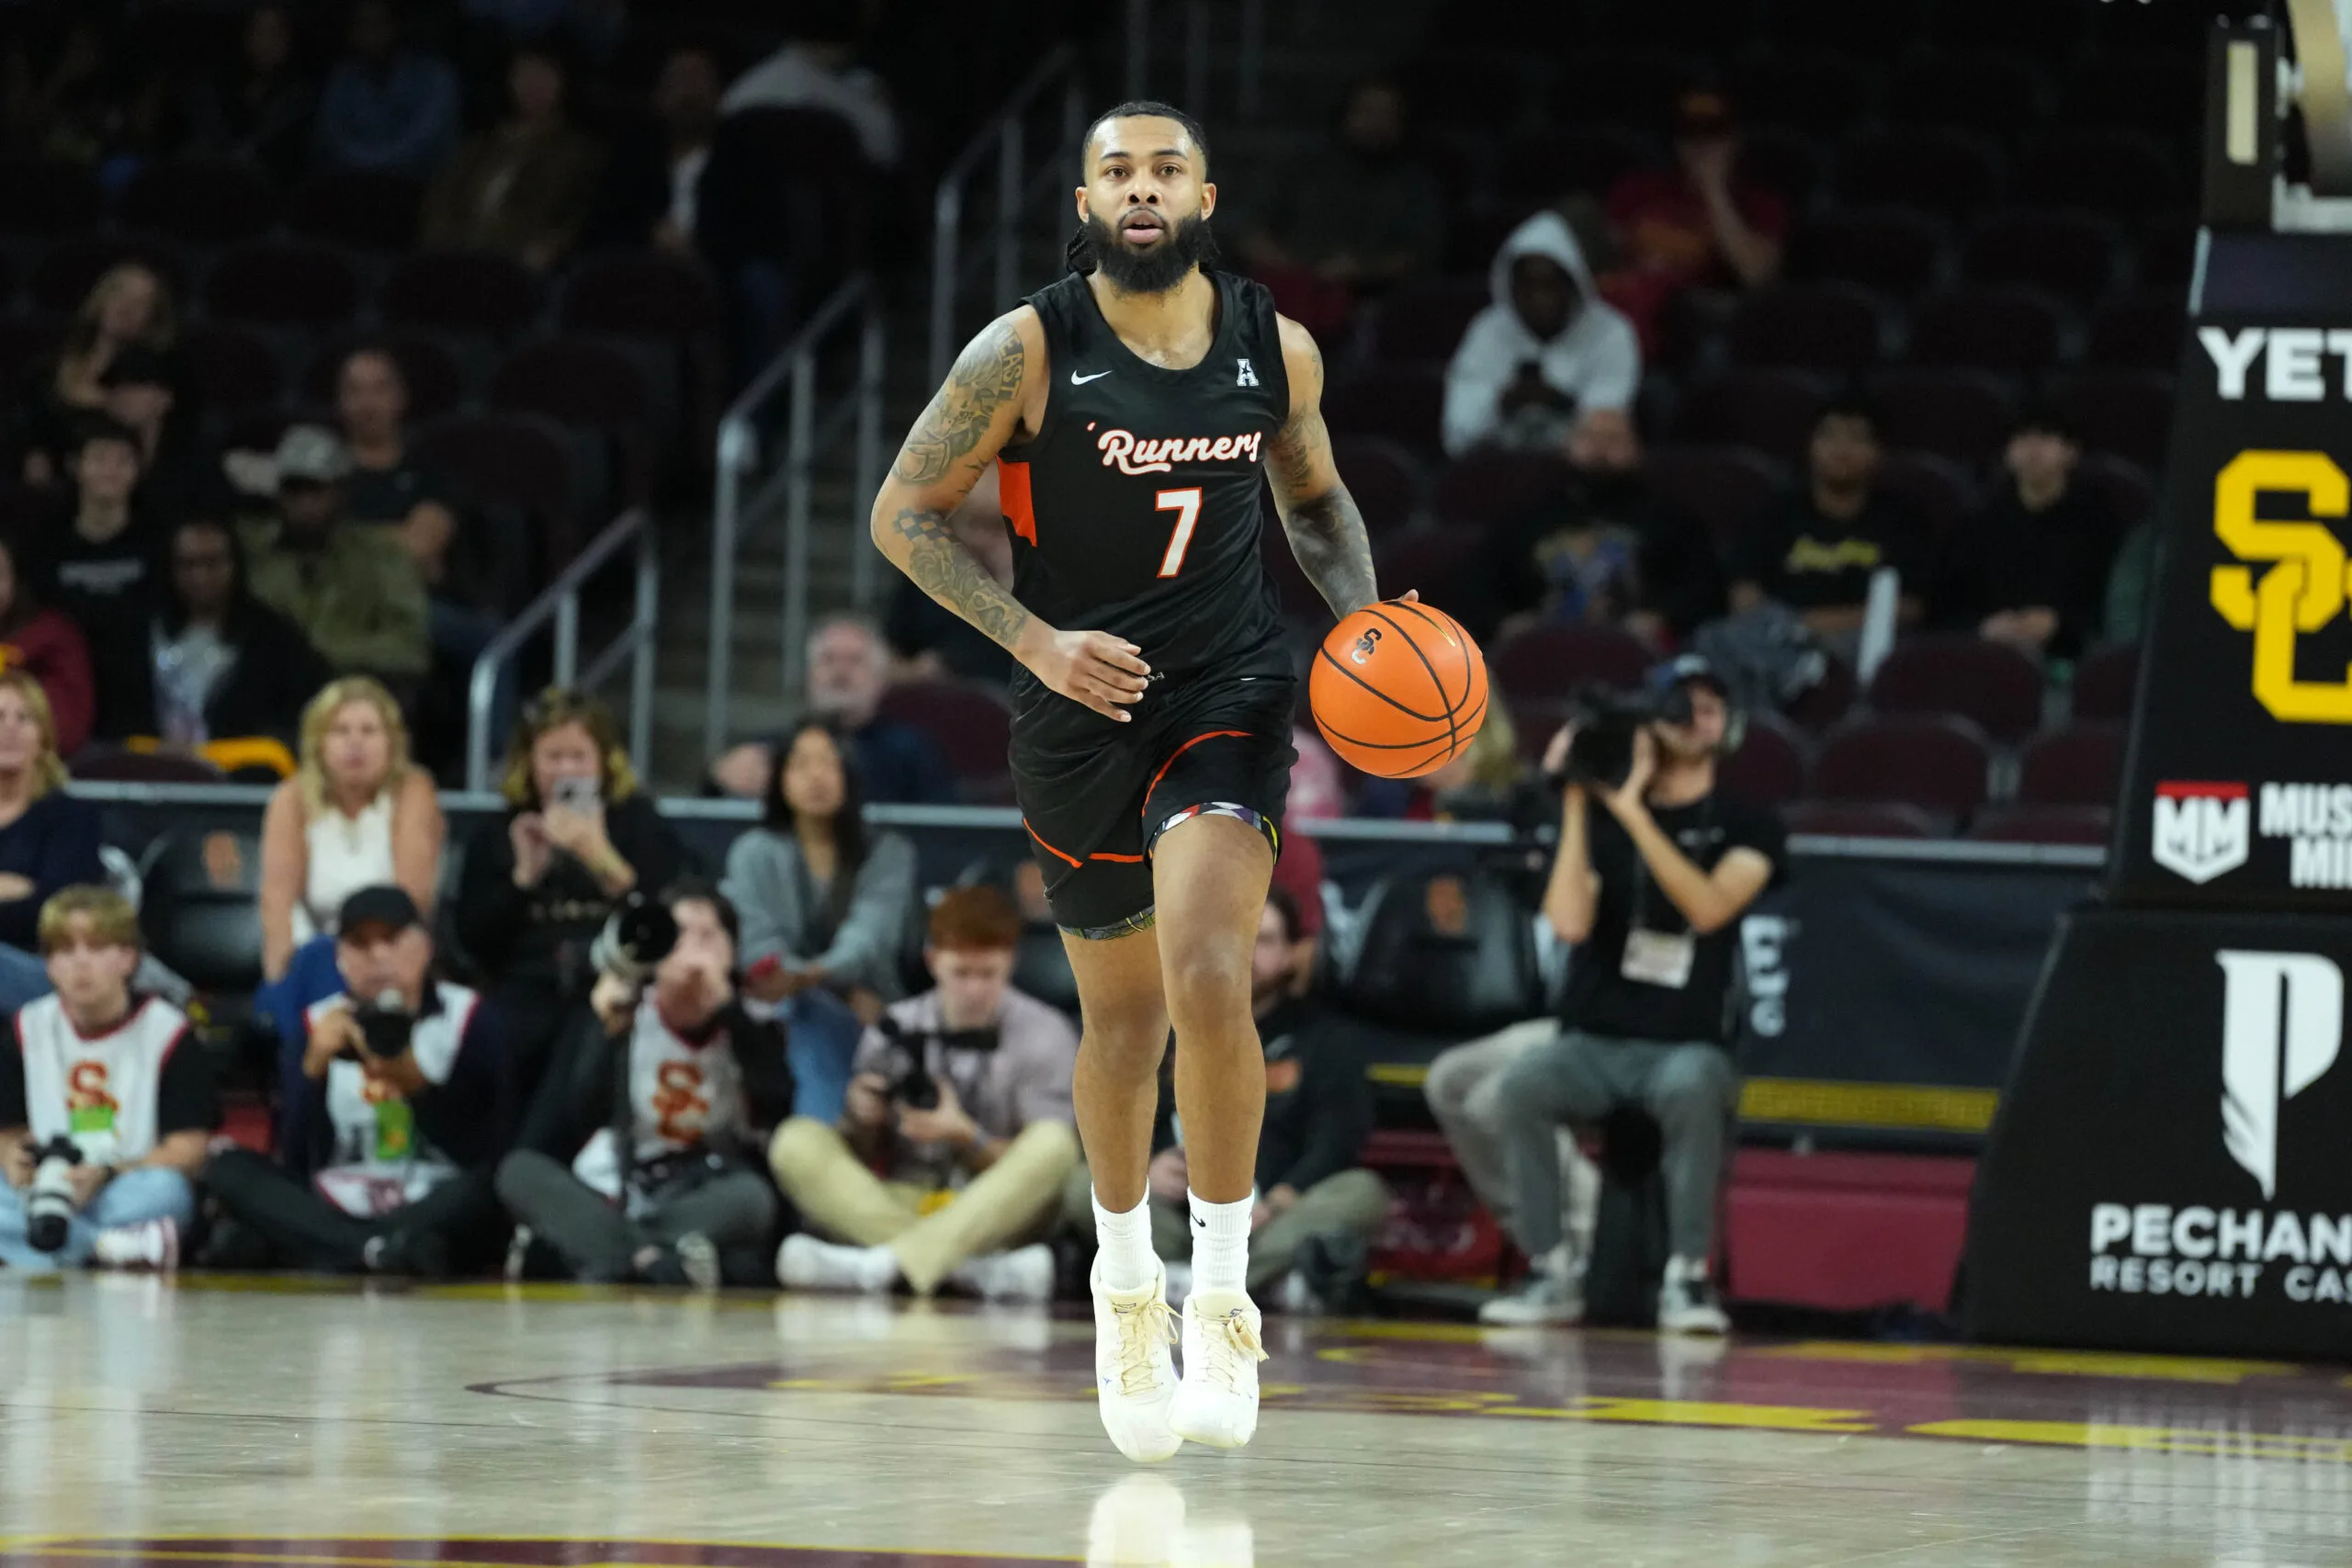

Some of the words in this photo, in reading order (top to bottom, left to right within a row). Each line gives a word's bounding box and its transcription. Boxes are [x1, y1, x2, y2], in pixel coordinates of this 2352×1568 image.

[1155, 486, 1203, 578] 7
[2210, 449, 2352, 724] SC
[1351, 627, 1383, 665] SC
[2290, 833, 2352, 889] MI
[2090, 1202, 2352, 1267] PECHAN
[2089, 1255, 2264, 1299] RESORT
[2284, 1265, 2352, 1304] CA
